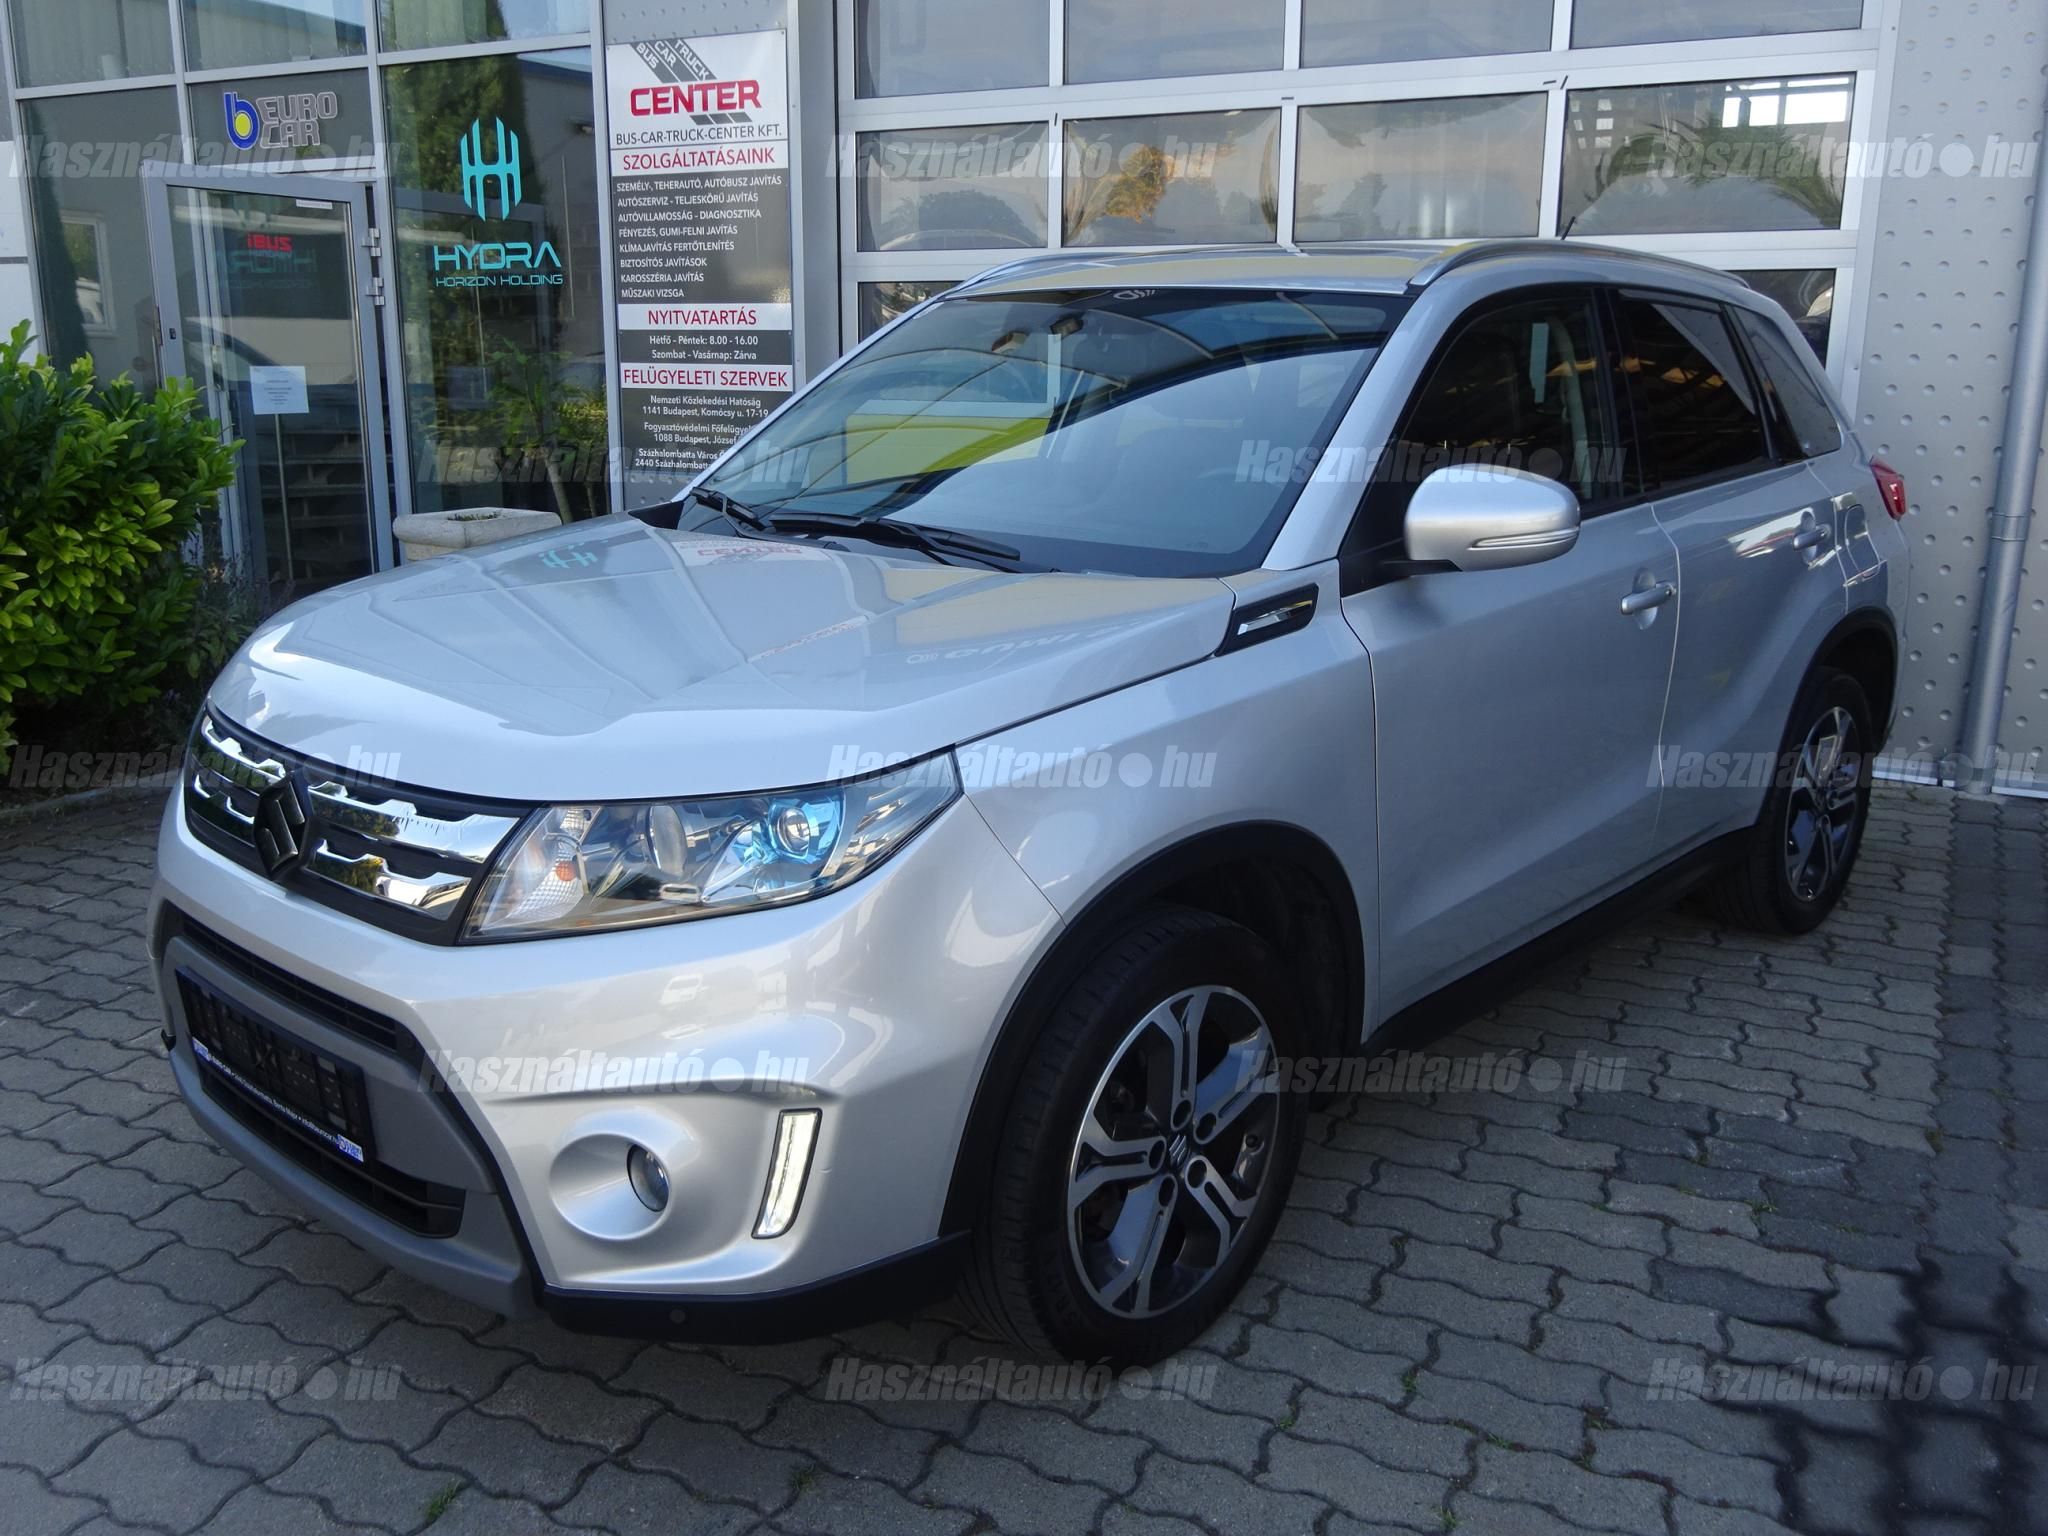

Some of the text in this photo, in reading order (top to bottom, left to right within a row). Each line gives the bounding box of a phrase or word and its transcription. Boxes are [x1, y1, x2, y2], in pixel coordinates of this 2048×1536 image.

[637, 43, 660, 69] BUS
[654, 41, 676, 67] CAR
[674, 40, 710, 80] TRUCK
[630, 80, 762, 117] CENTER
[256, 91, 338, 124] EURO
[260, 120, 321, 149] CAR
[616, 124, 782, 145] BUS-CAR-TRUCK-CENTER KFT.
[623, 146, 775, 171] SZOLGÁLTATÁSAINK
[654, 178, 703, 191] TEHERAUTÓ,
[704, 176, 748, 188] AUTÓBUSZ
[750, 175, 782, 187] JAVÍTÁS
[617, 196, 669, 208] AUTÓSZERVIZ
[726, 192, 759, 204] JAVÍTÁS
[618, 210, 693, 222] AUTÓVILLAMOSSÁG
[699, 209, 762, 220] DIAGNOSZTIKA
[618, 225, 738, 238] FÉNYEZÉS, GUMI-FELNI JAVÍTÁS
[619, 240, 735, 253] KLÍMAJAVÍTÁS FERTŐTLENÍTÉS
[433, 241, 562, 271] HYDRA
[620, 256, 707, 268] BIZTOSÍTÓS JAVÍTÁSOK
[436, 274, 563, 287] HORIZON HOLDING
[621, 272, 704, 284] KAROSSZÉRIA JAVÍTÁS
[655, 288, 685, 298] VIZSGA
[648, 306, 757, 327] NYITVATARTÁS
[649, 335, 671, 346] Hétfő
[678, 335, 708, 346] Péntek:
[709, 336, 727, 346] 8.00
[734, 336, 759, 346] 16.00
[652, 350, 686, 360] Szombat
[693, 350, 732, 362] Vasárnap:
[734, 350, 757, 361] Zárva
[623, 366, 788, 388] FELÜGYELETI SZERVEK
[650, 395, 761, 409] Nemzeti Közlekedési Hatóság
[642, 406, 661, 415] 1141
[663, 407, 700, 418] Budapest,
[701, 408, 736, 419] Komócsy
[745, 409, 769, 419] 17-19
[644, 422, 753, 435] Fogyasztóvédelmi Főfelügyel
[654, 434, 673, 442] 1088
[675, 434, 711, 445] Budapest,
[713, 436, 736, 445] József
[638, 448, 695, 459] Százhalombatta
[697, 450, 718, 460] Város
[635, 459, 711, 470] 2440 Százhalombatt
